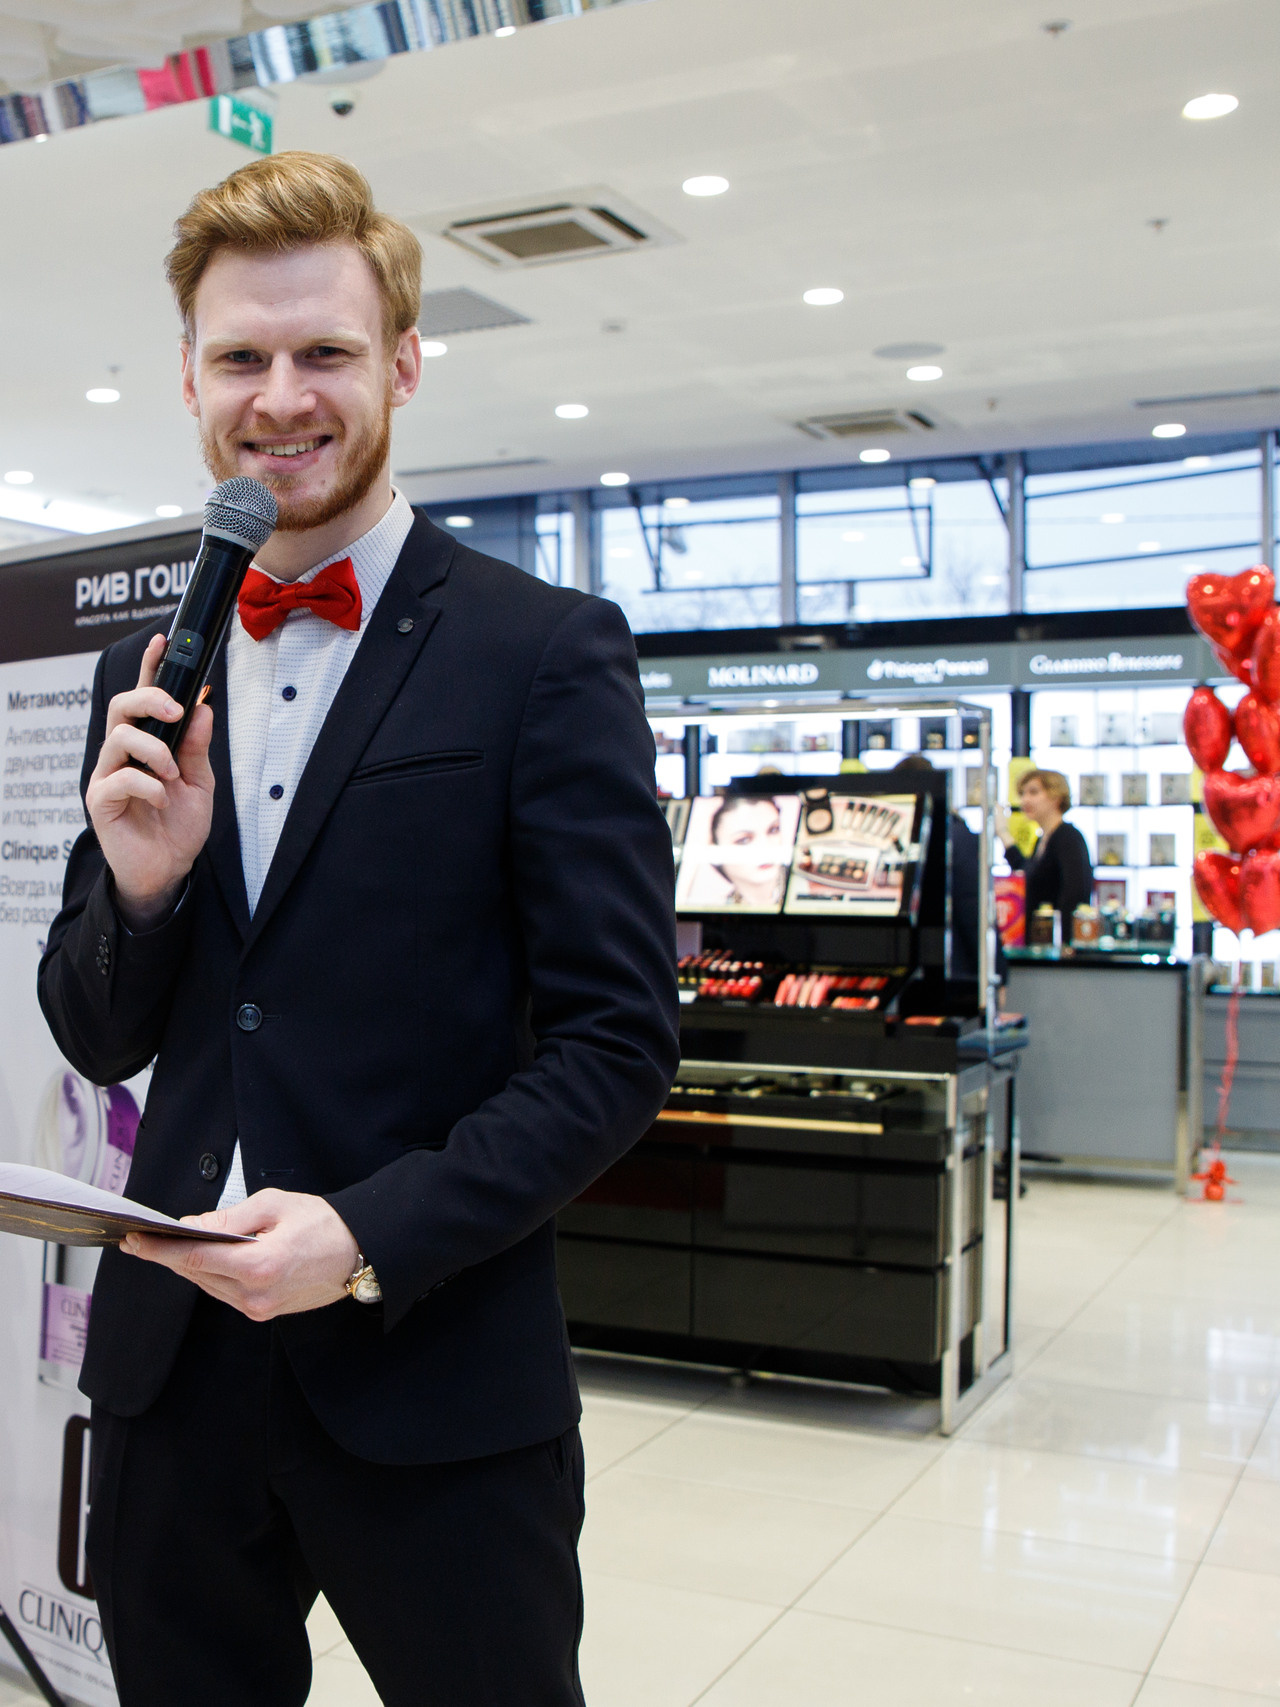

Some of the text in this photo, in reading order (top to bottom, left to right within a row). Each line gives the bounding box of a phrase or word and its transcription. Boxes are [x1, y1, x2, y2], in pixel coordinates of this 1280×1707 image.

[76, 561, 195, 609] РИВ ГОШ
[708, 663, 819, 687] MOLINARD
[7, 685, 91, 711] Метаморф
[1, 840, 59, 864] Clinique
[0, 875, 46, 899] Всегда
[19, 1589, 105, 1662] CLINIQ
